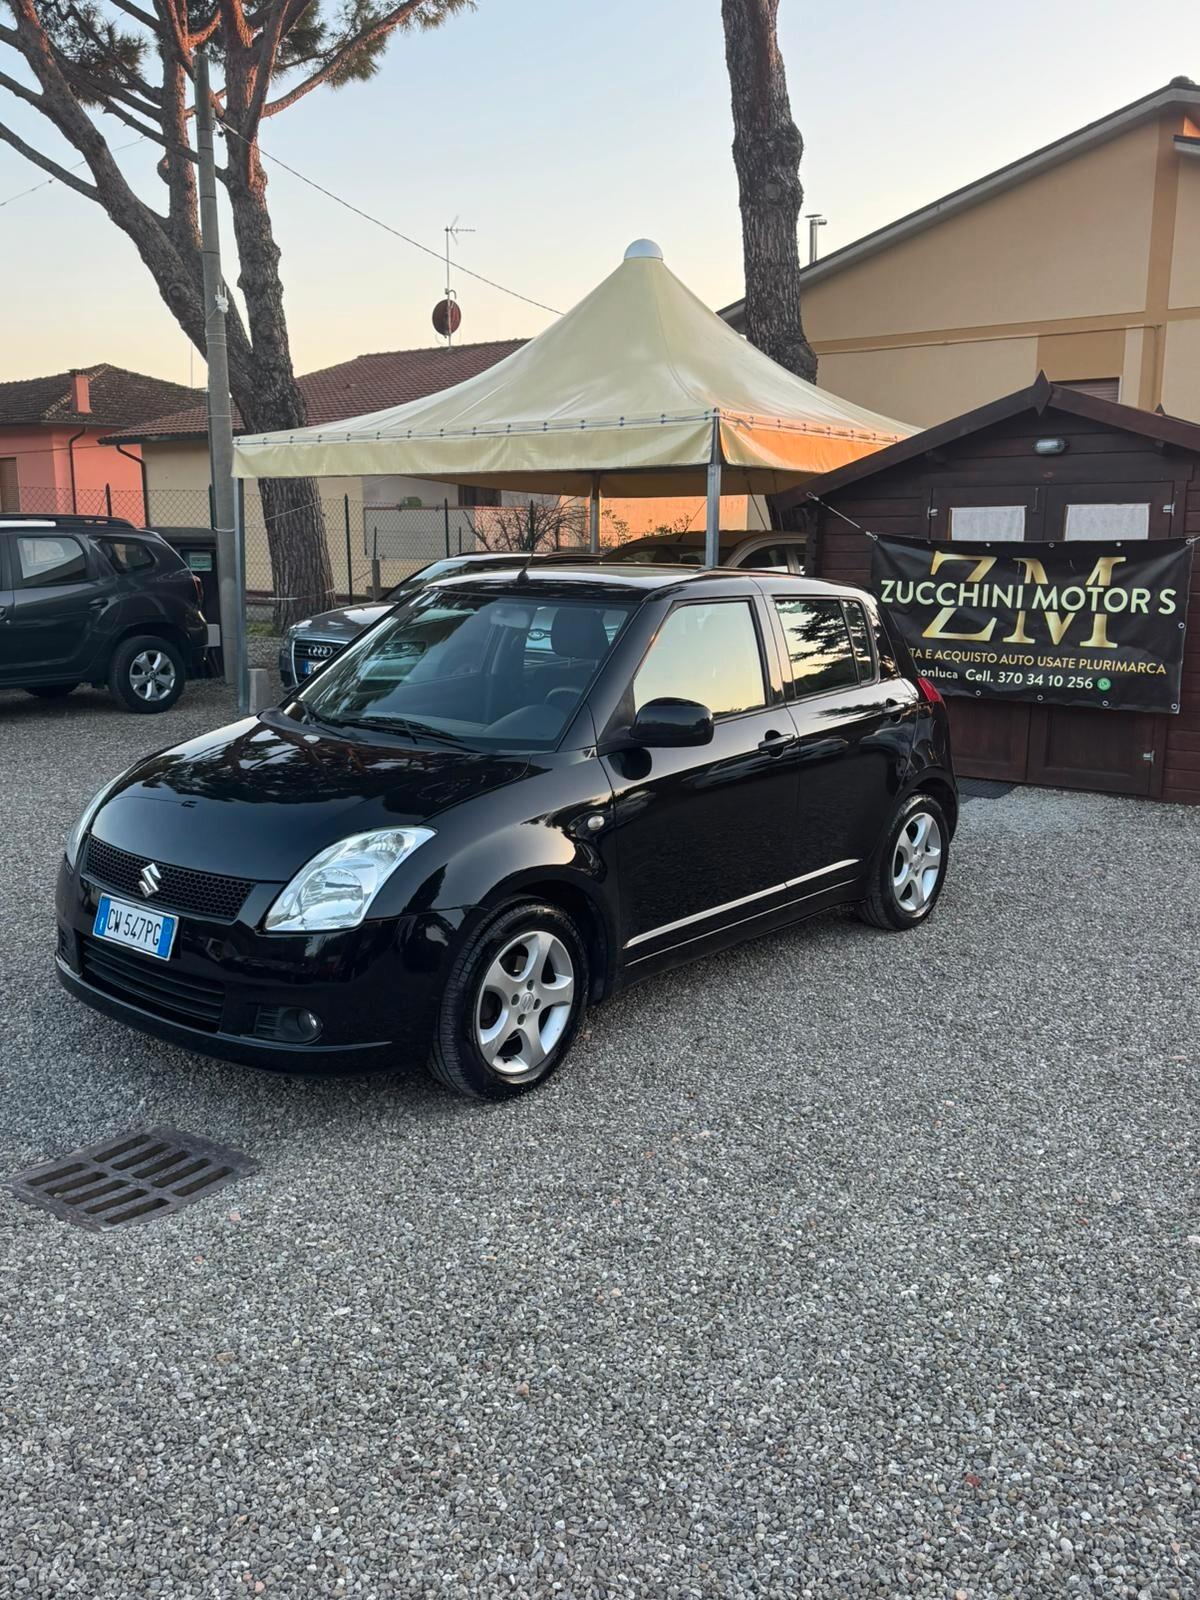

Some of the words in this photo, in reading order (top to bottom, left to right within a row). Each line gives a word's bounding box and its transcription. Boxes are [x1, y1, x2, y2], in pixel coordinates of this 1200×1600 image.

[880, 579, 1024, 609] ZUCCHINI
[921, 550, 1127, 649] ZM
[925, 648, 933, 659] E
[934, 649, 997, 664] ACQUISTO
[999, 654, 1035, 666] AUTO
[1037, 655, 1076, 669] USATE
[1078, 658, 1167, 675] PLURIMARCA
[918, 666, 958, 679] onluca
[965, 668, 994, 682] Cell.
[998, 671, 1023, 685] 370
[1026, 673, 1044, 686] 34
[1047, 675, 1064, 687] 10
[1067, 676, 1094, 689] 256
[107, 909, 122, 933] CW
